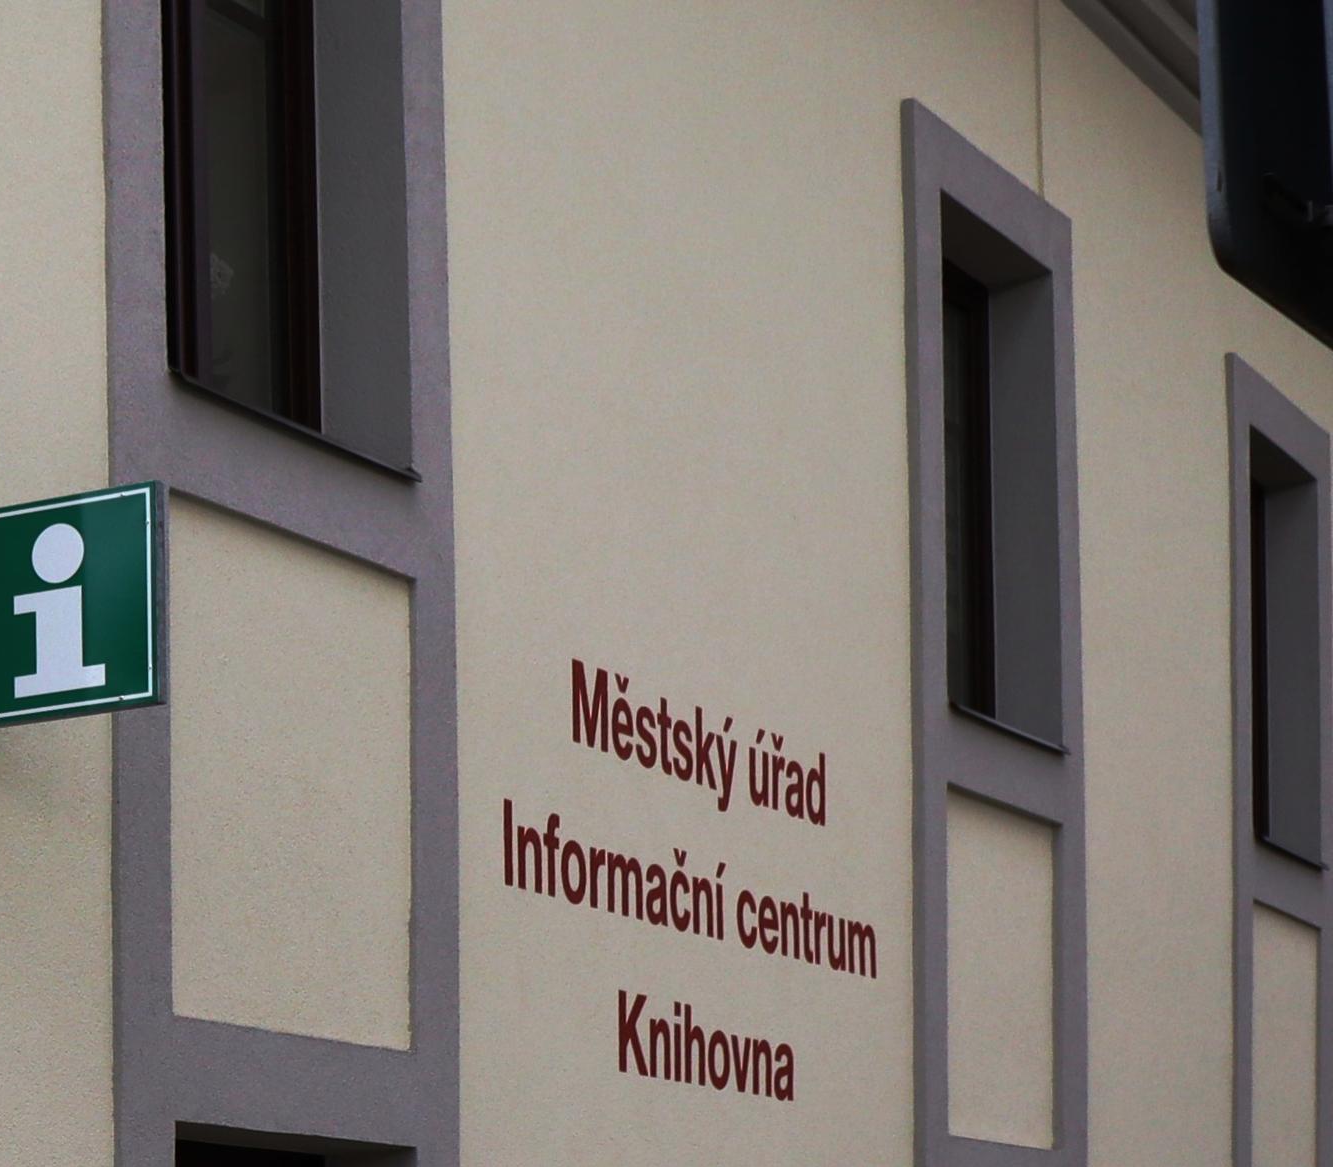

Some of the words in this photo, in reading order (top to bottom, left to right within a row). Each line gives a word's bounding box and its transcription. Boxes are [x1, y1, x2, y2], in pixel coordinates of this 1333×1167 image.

[14, 523, 106, 699] i
[571, 658, 737, 813] Městský
[748, 728, 826, 827] úřad
[503, 798, 727, 941] Informační
[736, 891, 878, 980] centrum
[618, 988, 795, 1102] Knihovna
